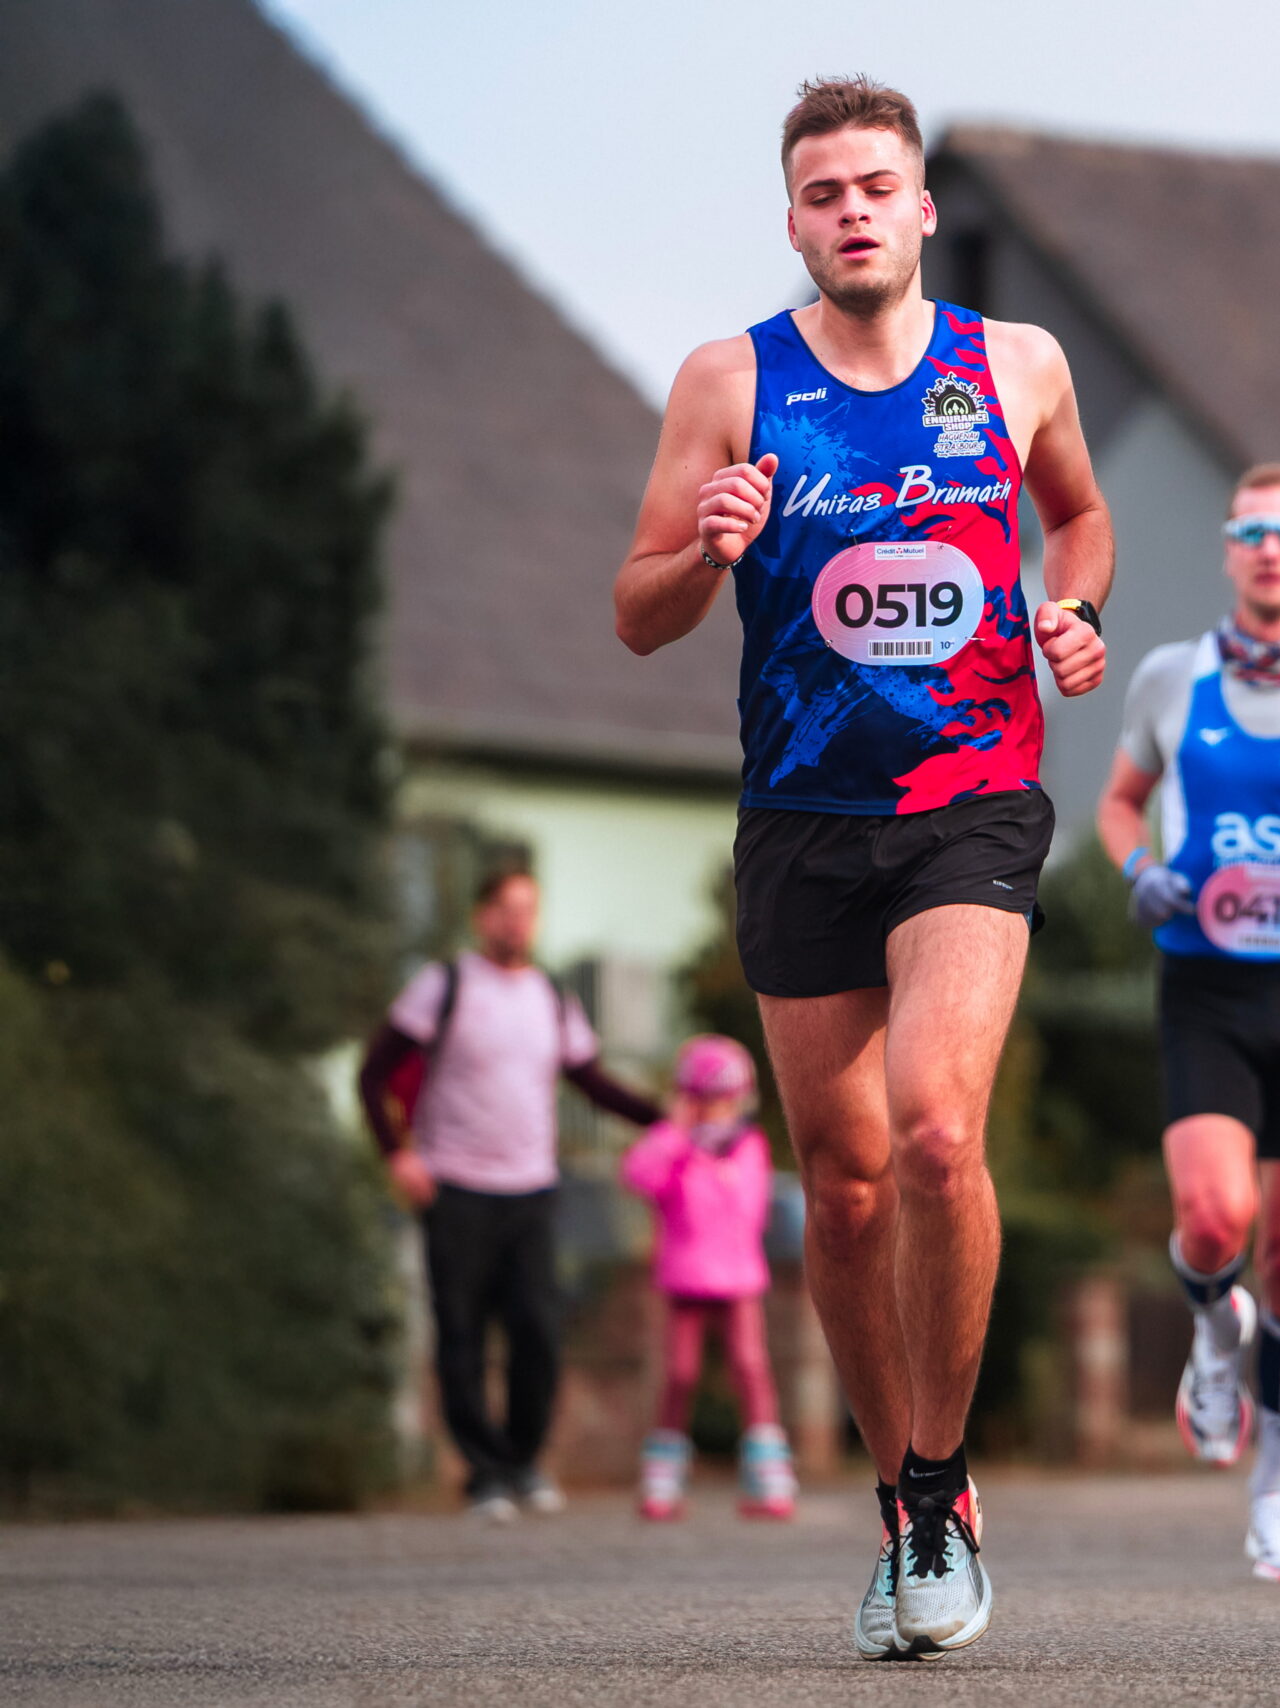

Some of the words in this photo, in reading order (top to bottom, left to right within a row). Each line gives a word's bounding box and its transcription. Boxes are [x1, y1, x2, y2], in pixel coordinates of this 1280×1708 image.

[785, 387, 828, 406] poli
[925, 413, 986, 425] ENDURANCE
[945, 422, 971, 431] SHOP
[939, 432, 979, 441] HAGUENAU
[935, 442, 985, 451] STRASBOURG
[782, 473, 882, 518] Unitas
[895, 465, 1013, 508] Brumath
[835, 581, 964, 629] 0519
